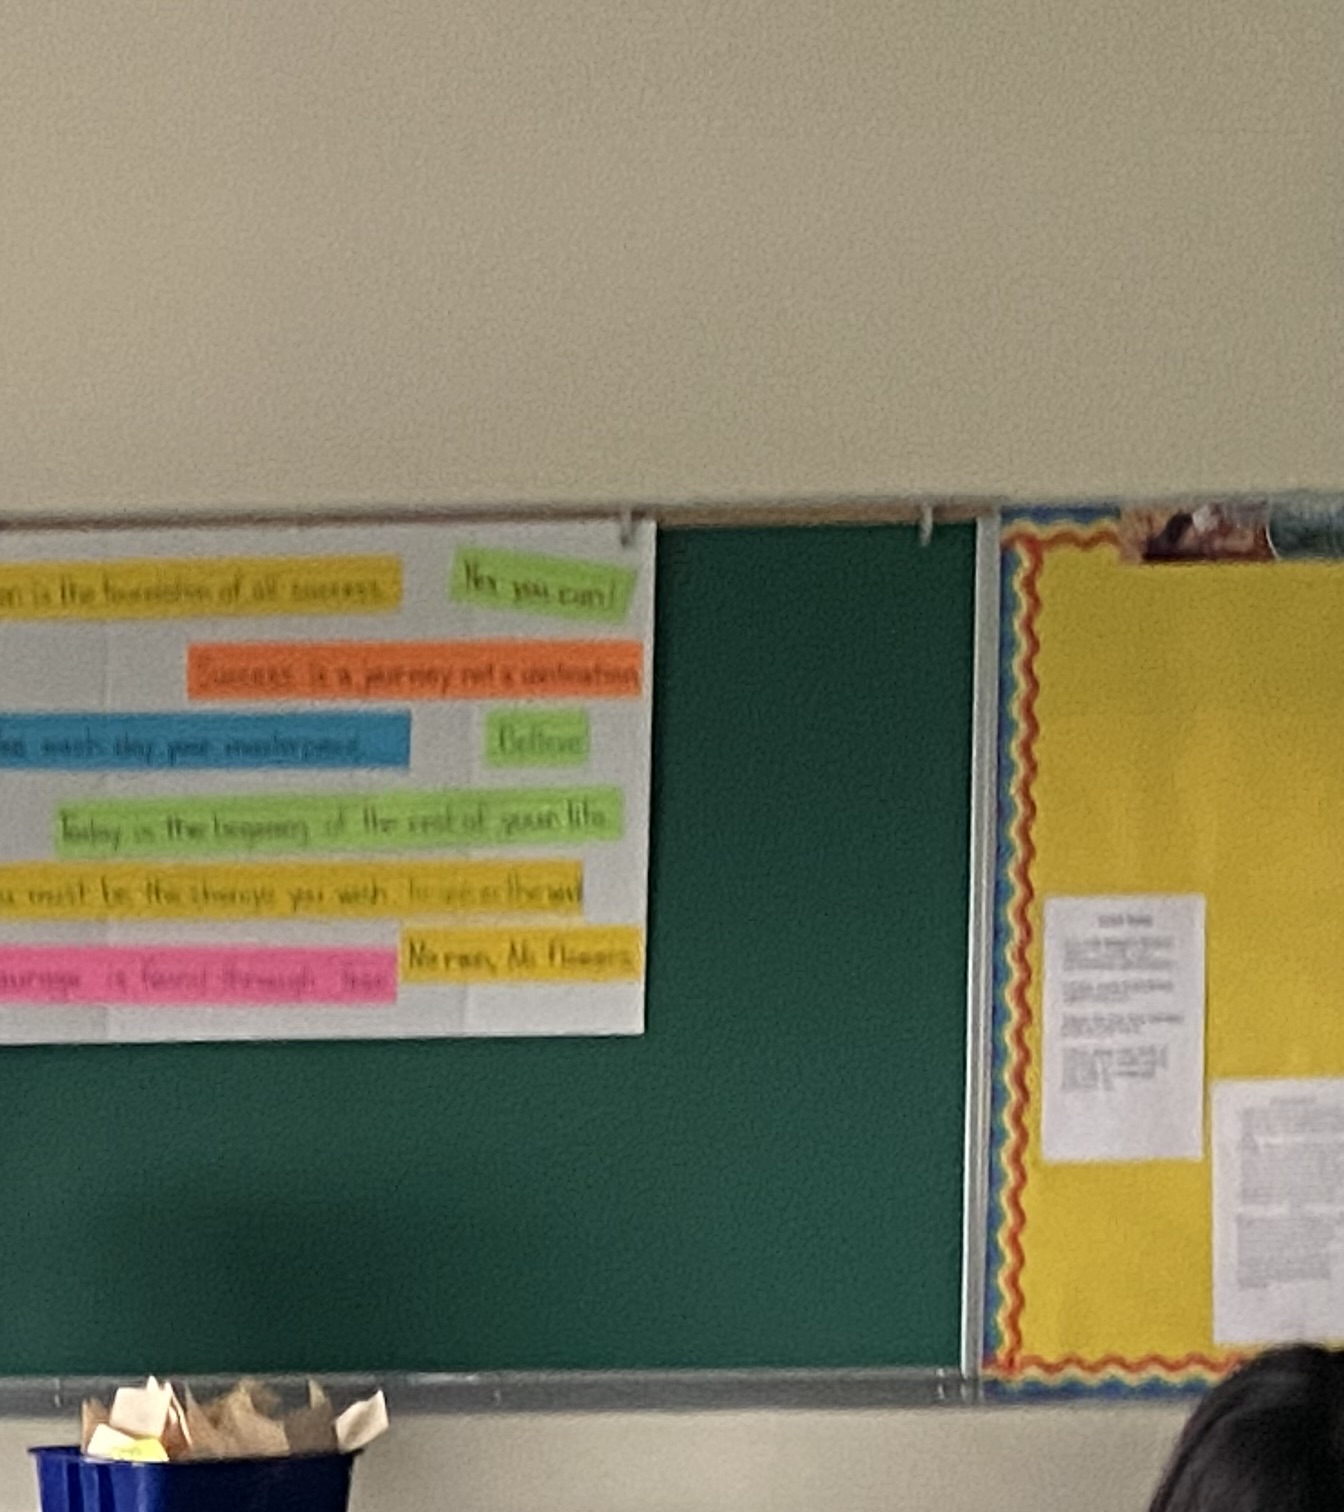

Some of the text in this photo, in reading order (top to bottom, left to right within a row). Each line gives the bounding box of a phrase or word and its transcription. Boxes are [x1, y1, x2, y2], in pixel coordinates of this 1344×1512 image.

[32, 578, 52, 606] is
[60, 574, 95, 605] the
[218, 569, 243, 602] of
[309, 662, 328, 687] is
[60, 810, 120, 850] Today
[166, 813, 205, 841] the
[362, 805, 396, 834] the
[146, 876, 181, 904] the
